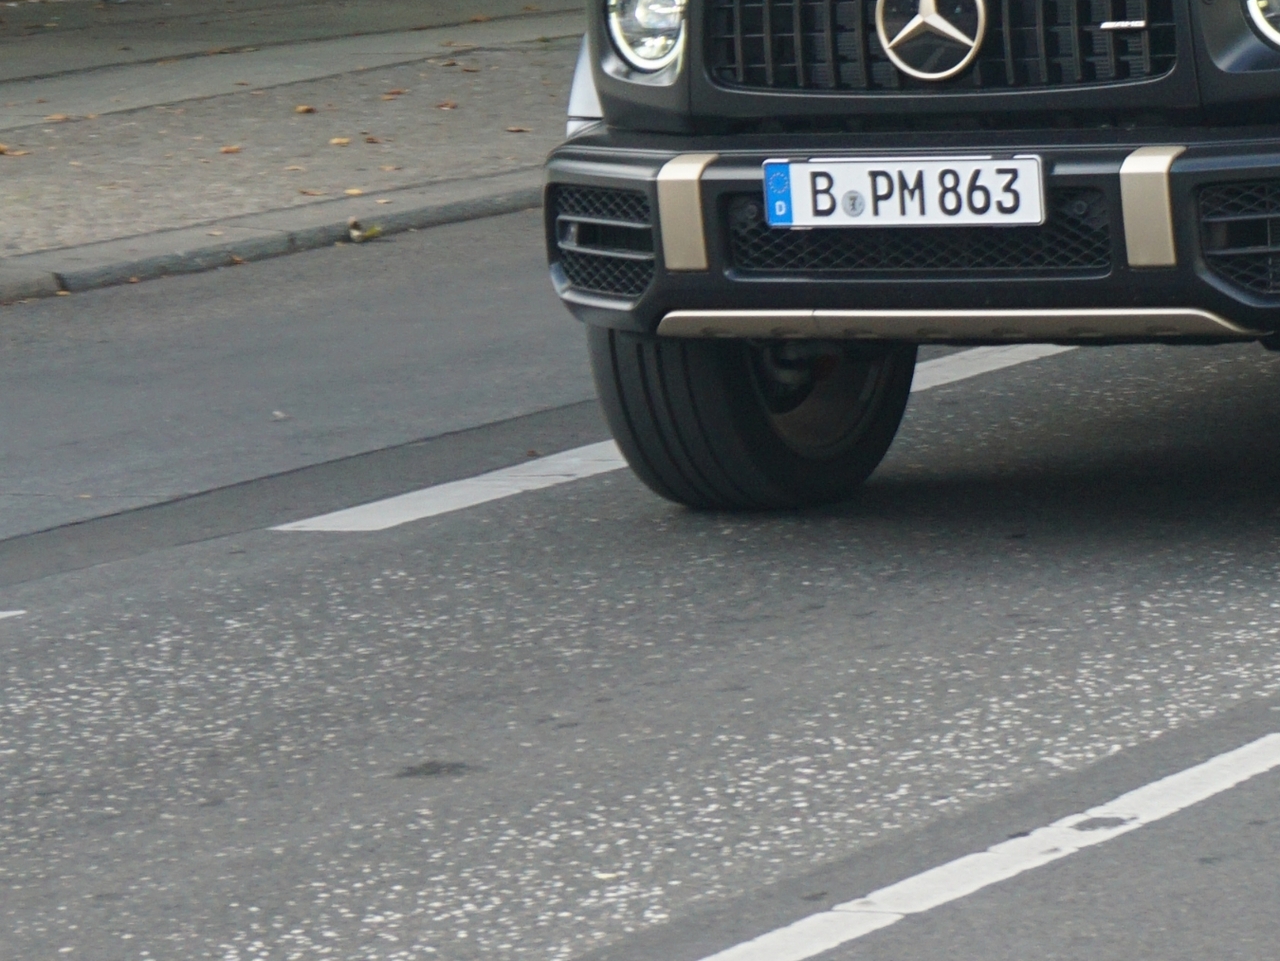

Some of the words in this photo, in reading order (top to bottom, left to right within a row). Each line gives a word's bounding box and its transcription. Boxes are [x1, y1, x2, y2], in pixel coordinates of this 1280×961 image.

[775, 201, 786, 216] D
[809, 170, 837, 217] B
[868, 169, 926, 216] PM
[938, 168, 1021, 216] 863
